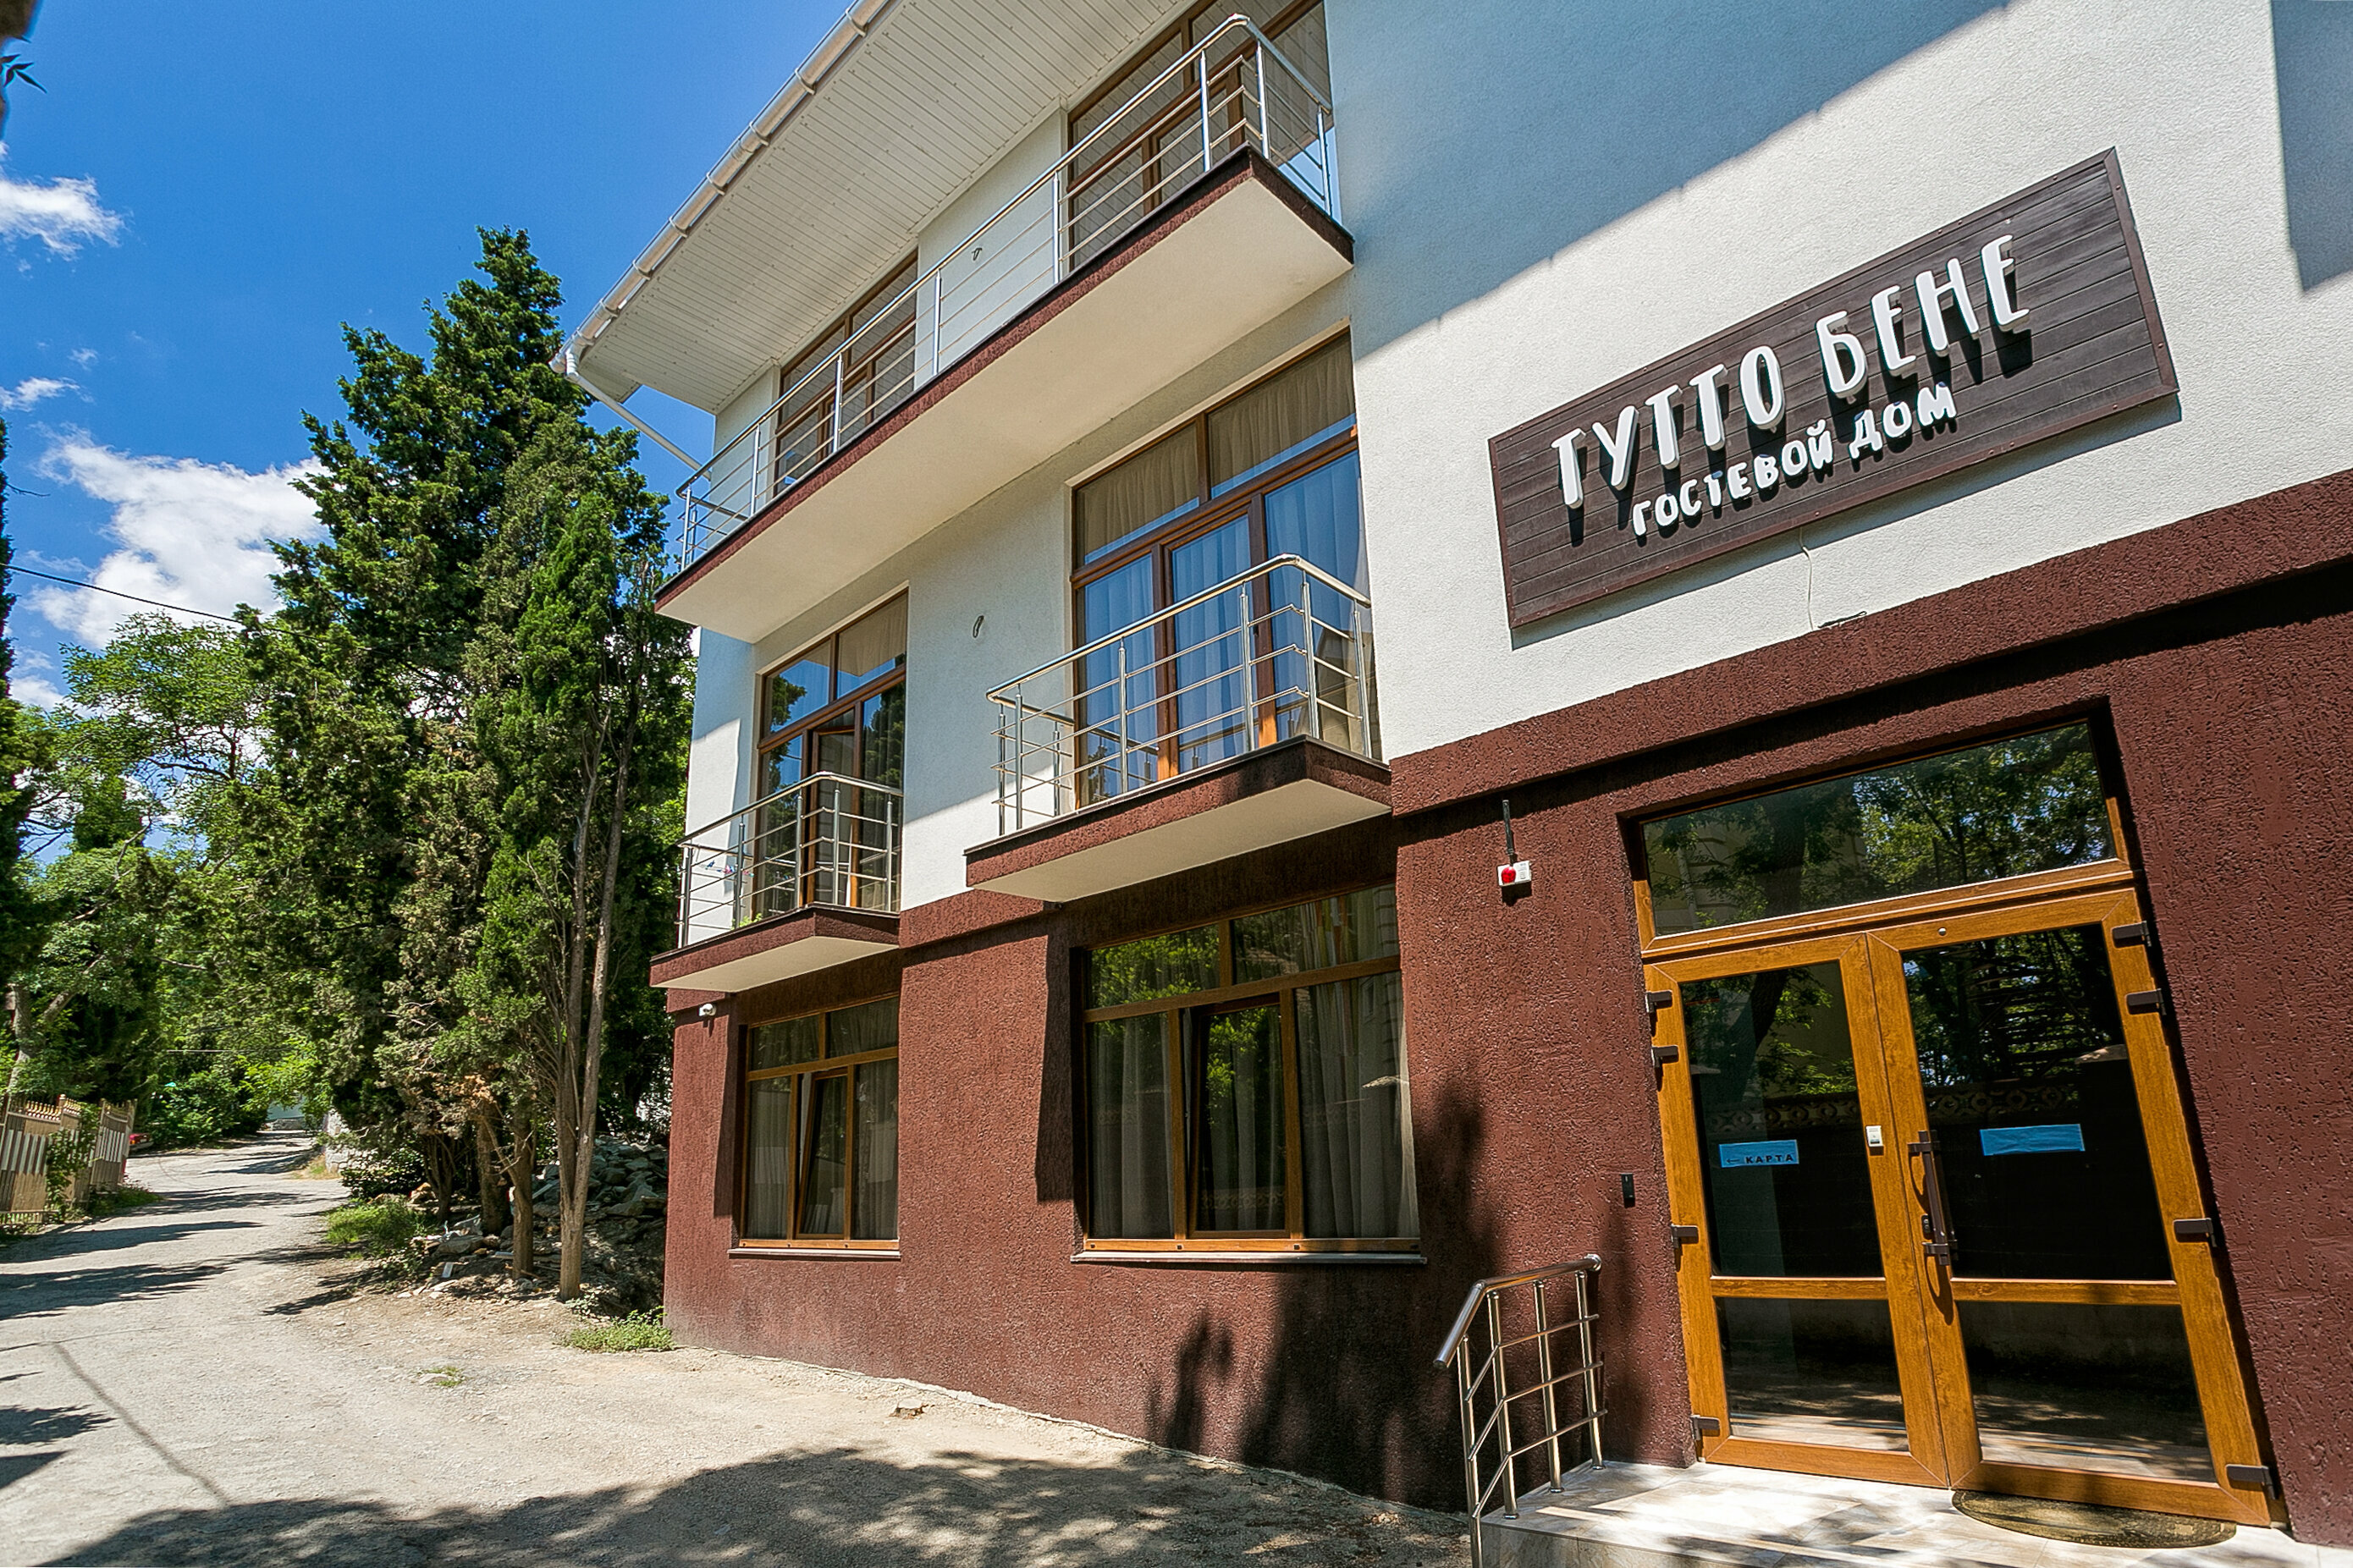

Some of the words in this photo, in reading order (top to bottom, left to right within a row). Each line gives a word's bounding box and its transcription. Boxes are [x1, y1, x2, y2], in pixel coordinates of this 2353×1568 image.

[1551, 345, 1785, 509] ТУТТО
[1816, 234, 2031, 399] БЕНЕ
[1632, 419, 1834, 536] ГОСТЕВОЙ
[1847, 381, 1958, 460] ДОМ
[1745, 1153, 1794, 1164] КАРТА
